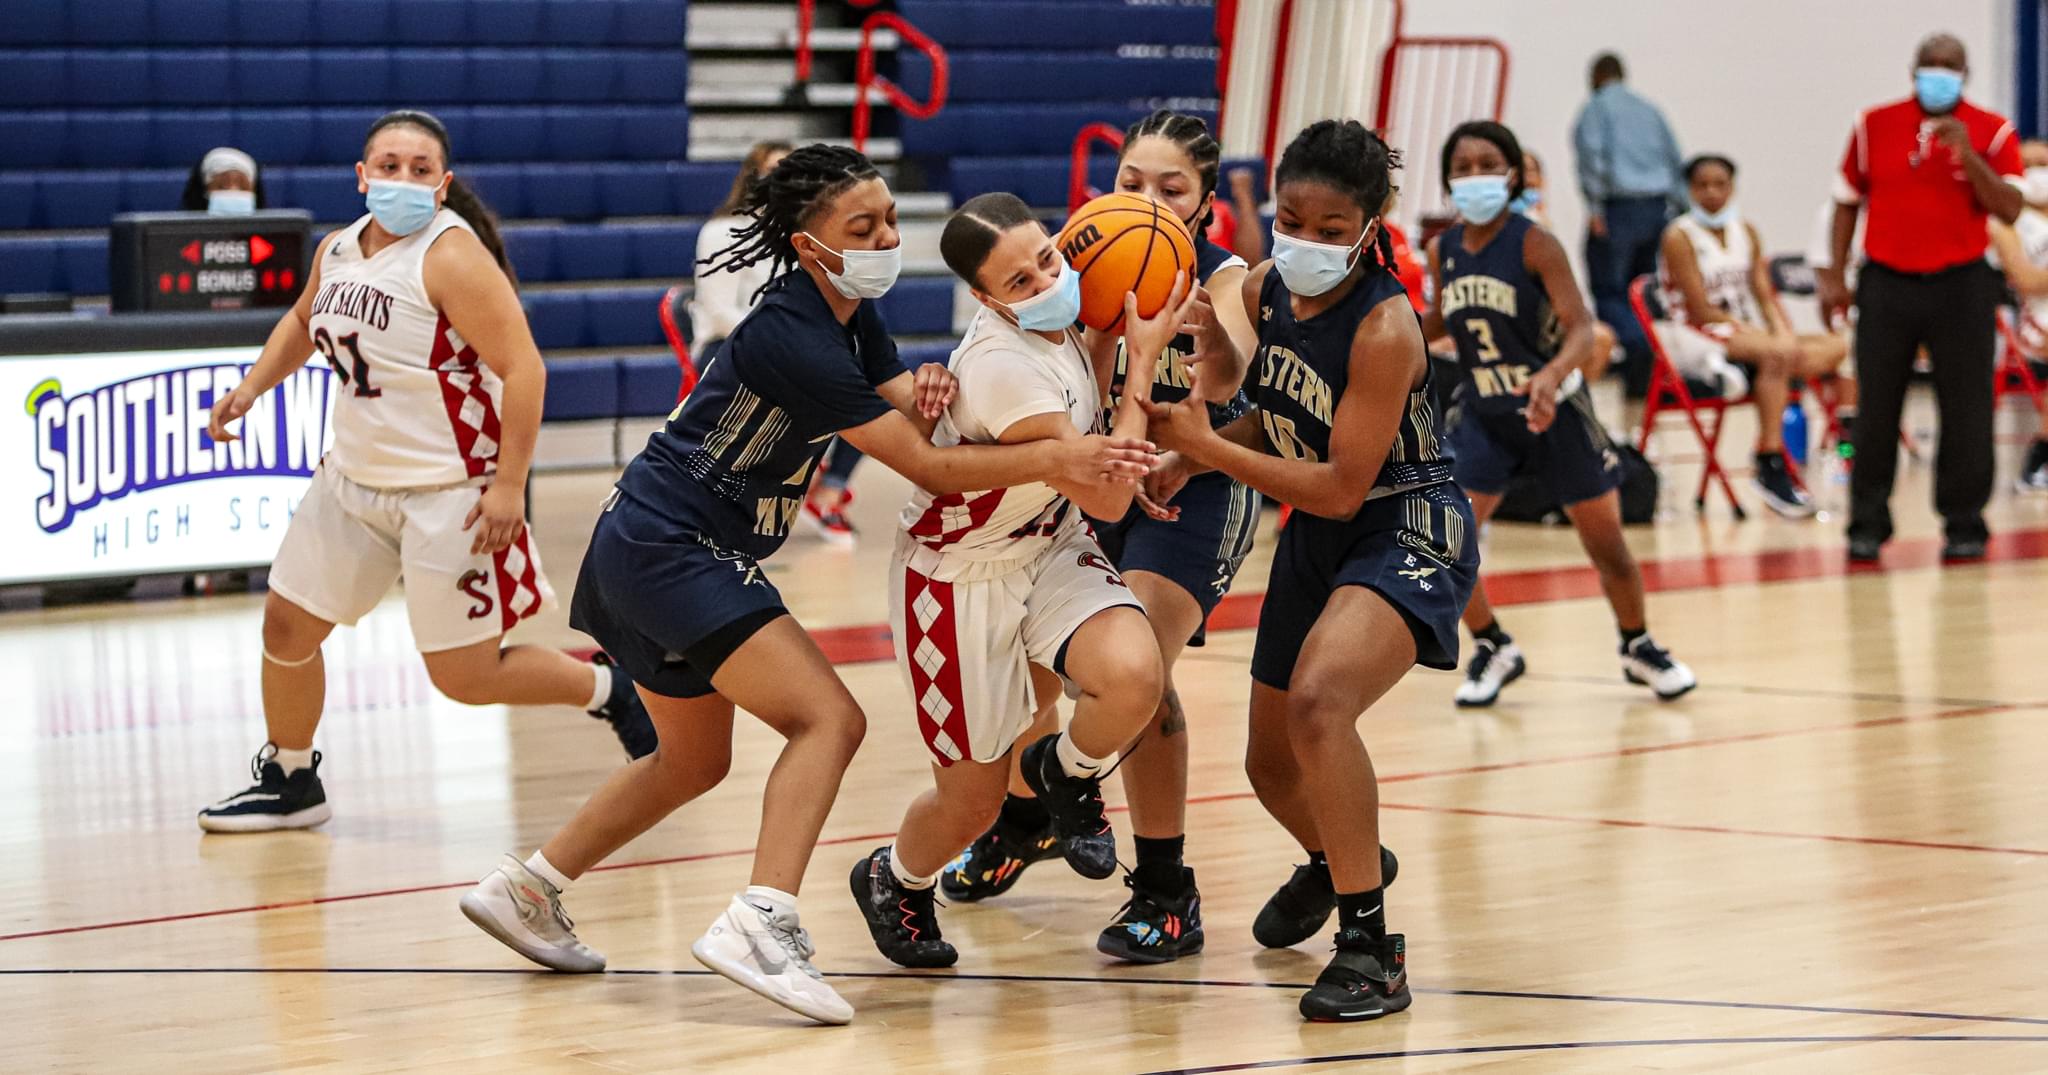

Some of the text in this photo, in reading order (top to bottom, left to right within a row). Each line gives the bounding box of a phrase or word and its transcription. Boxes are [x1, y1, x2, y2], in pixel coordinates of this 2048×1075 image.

[197, 269, 257, 293] BONUS
[333, 281, 395, 332] SAINTS
[1441, 275, 1518, 317] EASTERN
[1465, 317, 1502, 362] 3
[1259, 345, 1333, 428] STERN
[37, 365, 279, 532] SOUTHERN
[93, 504, 190, 558] HIGH
[1403, 553, 1417, 567] E
[464, 568, 494, 621] S
